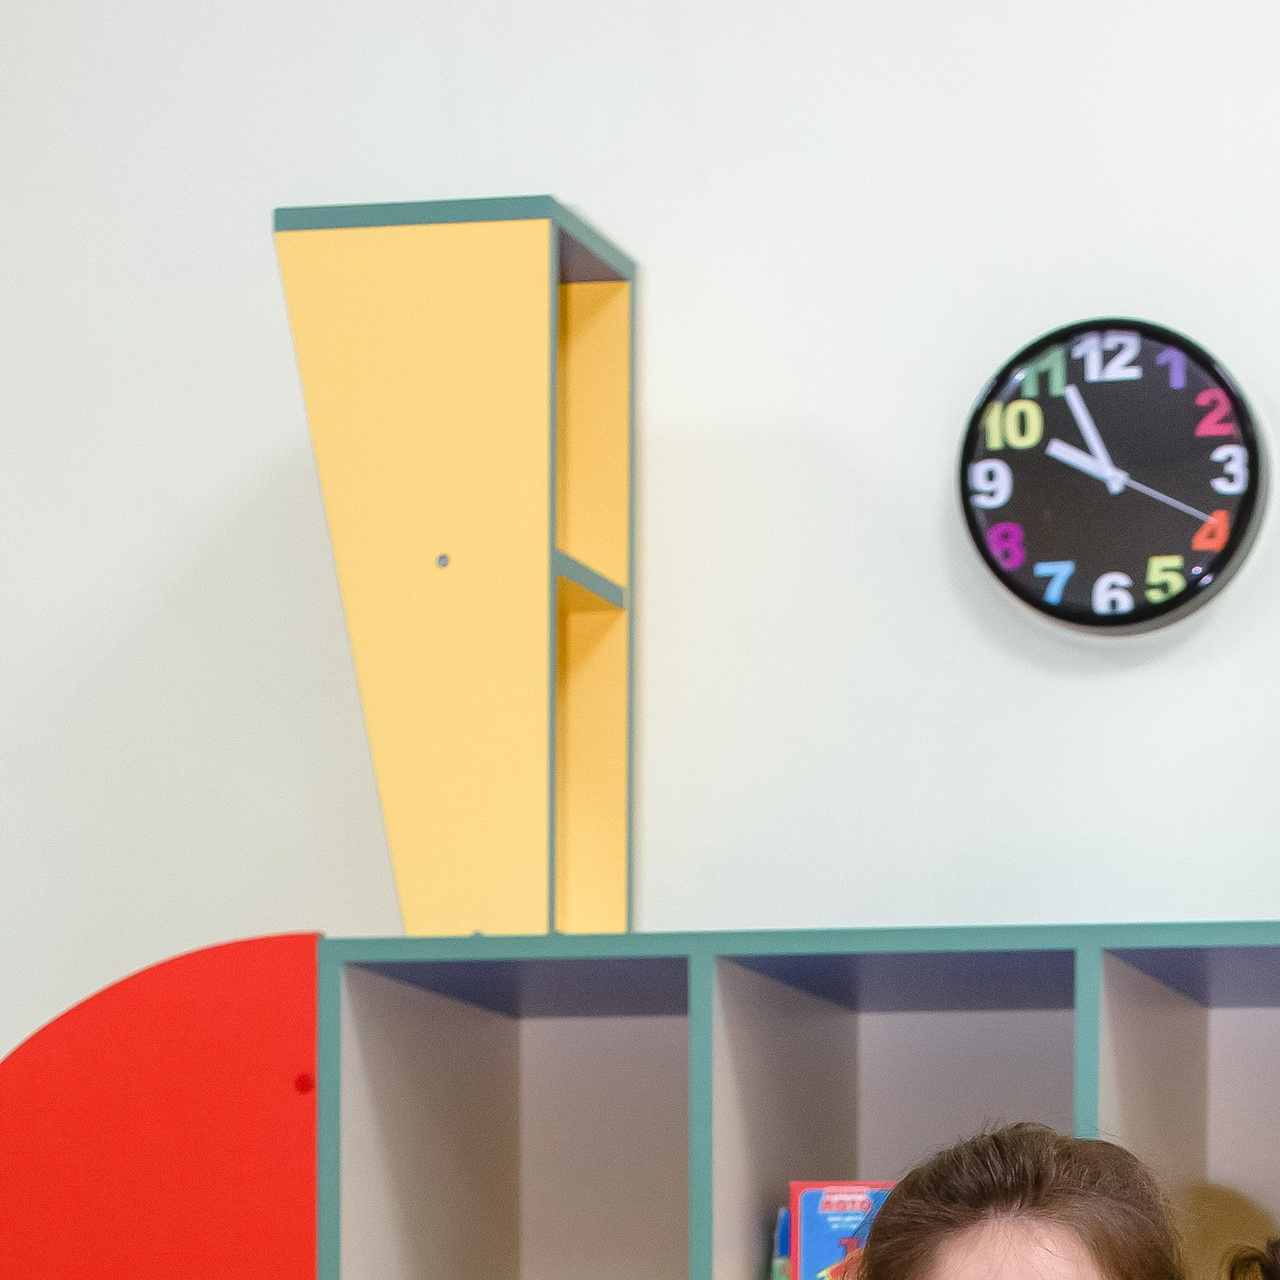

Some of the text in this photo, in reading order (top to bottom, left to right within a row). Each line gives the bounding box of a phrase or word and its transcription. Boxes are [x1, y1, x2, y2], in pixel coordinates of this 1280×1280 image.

[1017, 347, 1067, 398] 11
[1071, 330, 1142, 383] 12
[1156, 346, 1187, 389] 1
[979, 399, 1044, 450] 10
[1194, 387, 1235, 437] 2
[967, 458, 1014, 510] 9
[1209, 444, 1249, 495] 3
[985, 522, 1026, 570] 8
[1191, 510, 1230, 552] 4
[1033, 561, 1076, 605] 7
[1091, 571, 1135, 616] 6
[1145, 555, 1187, 604] 5
